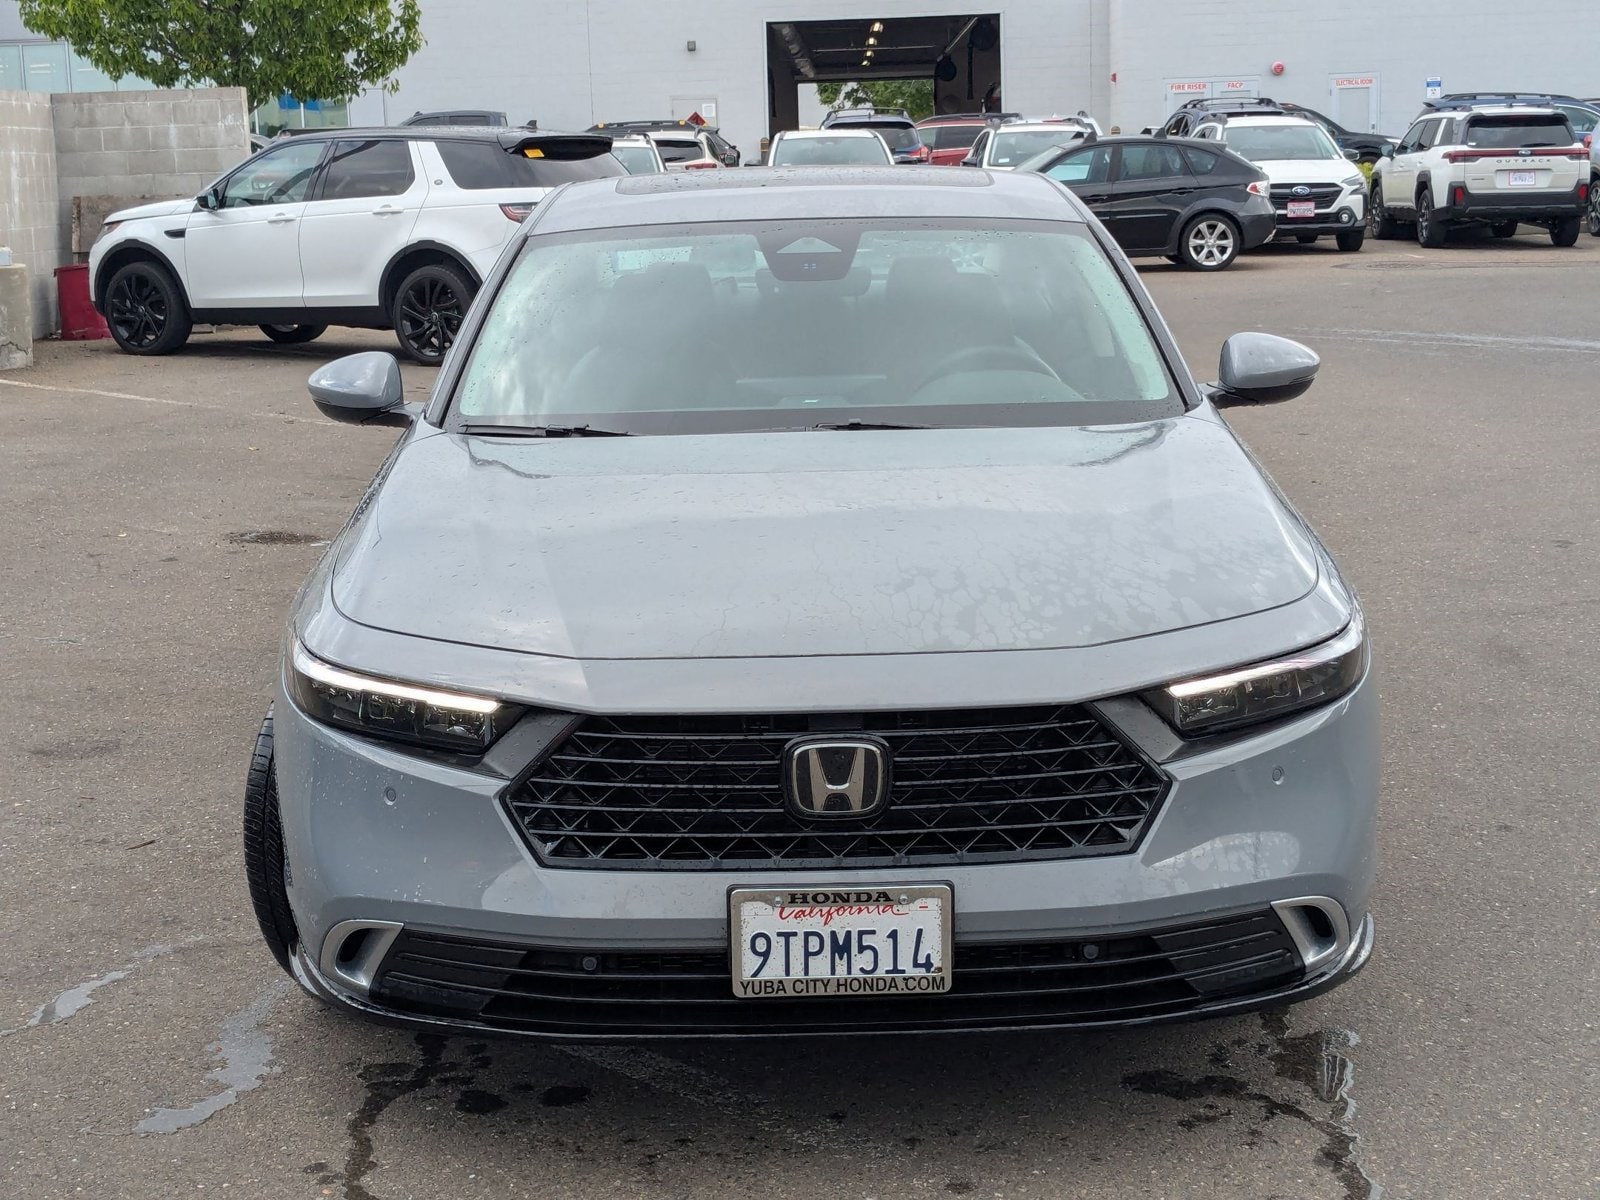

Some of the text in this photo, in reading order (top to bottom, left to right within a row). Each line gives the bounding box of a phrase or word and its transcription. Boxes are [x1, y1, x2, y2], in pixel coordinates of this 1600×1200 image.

[788, 891, 894, 905] HONDA
[779, 904, 909, 926] California
[749, 928, 935, 978] 9TPM514
[740, 979, 787, 995] YUBA
[792, 978, 831, 994] CITY
